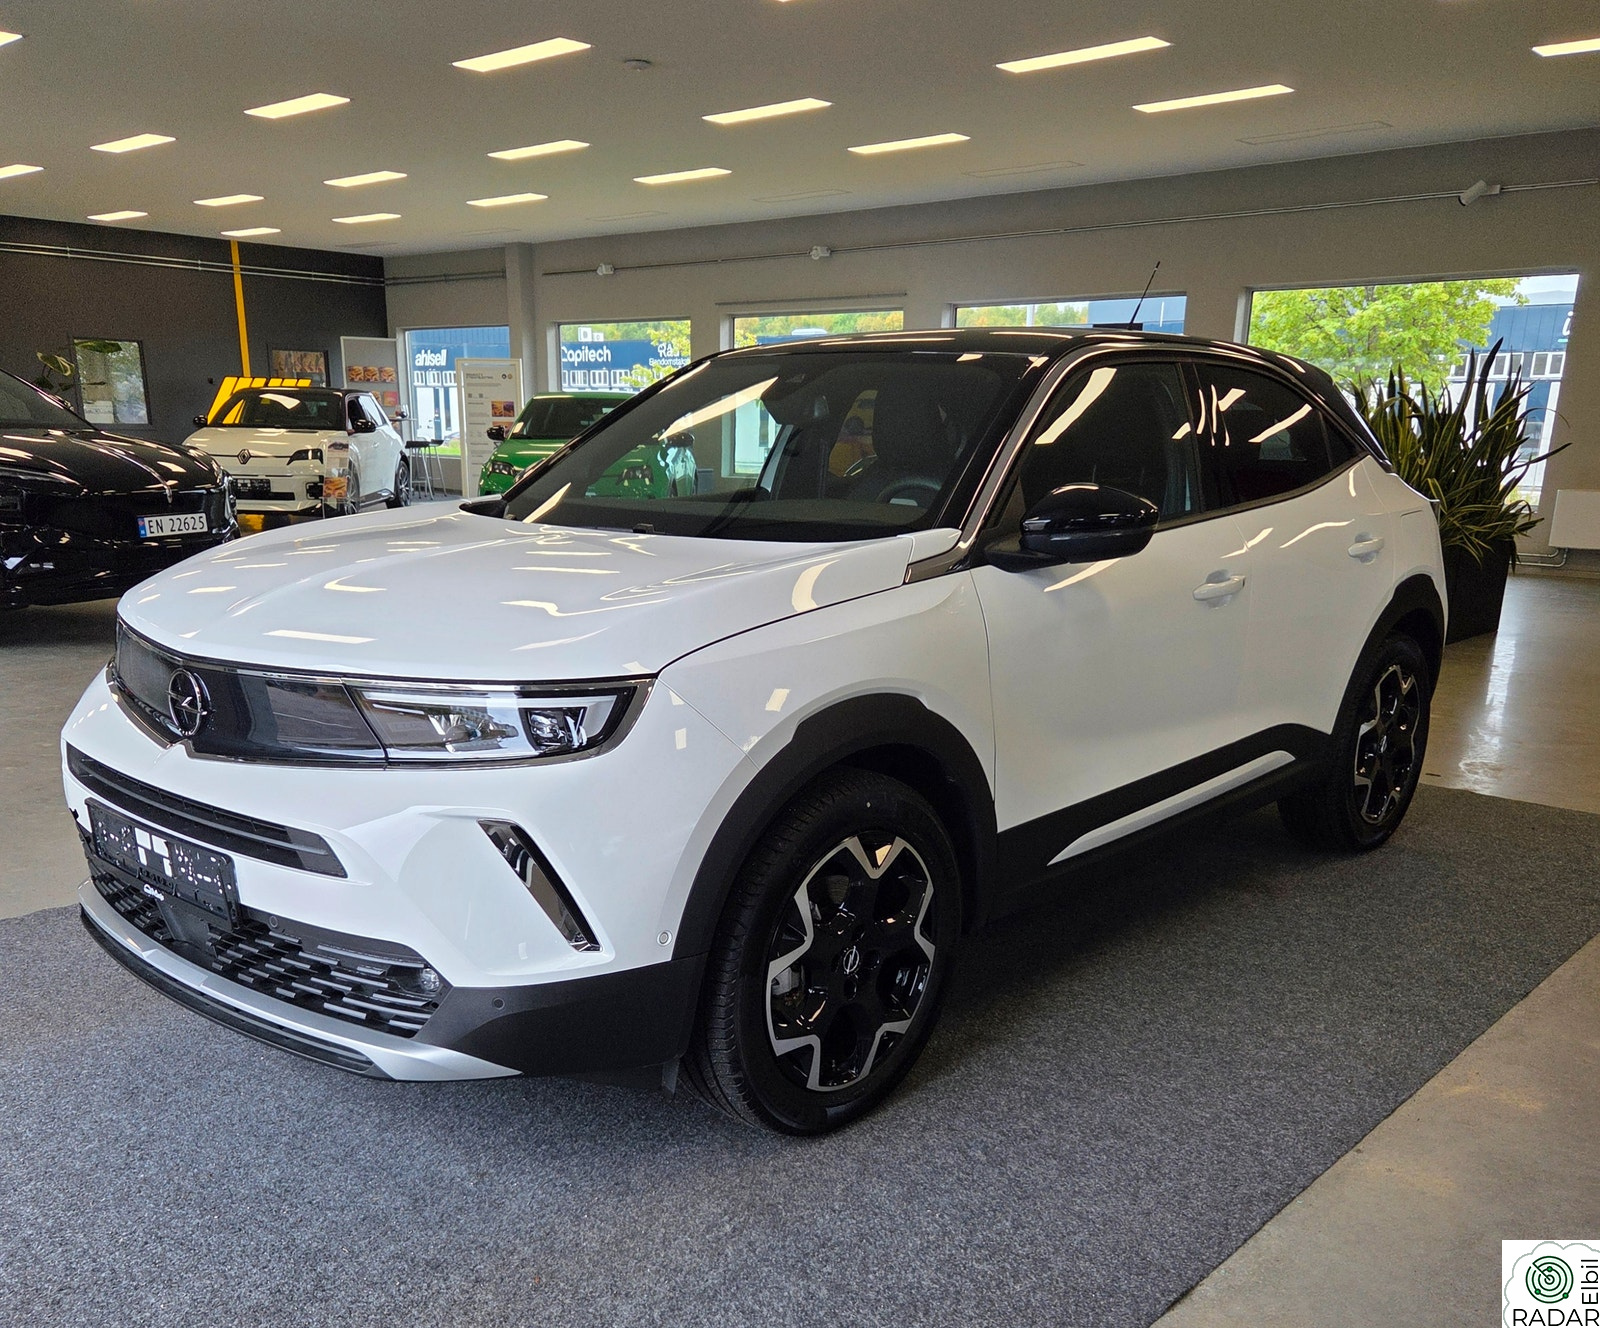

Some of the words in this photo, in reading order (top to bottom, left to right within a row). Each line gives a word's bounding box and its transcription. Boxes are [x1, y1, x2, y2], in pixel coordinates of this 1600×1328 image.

[415, 349, 447, 366] ahlsell
[148, 519, 164, 534] EN
[168, 516, 205, 532] 22625
